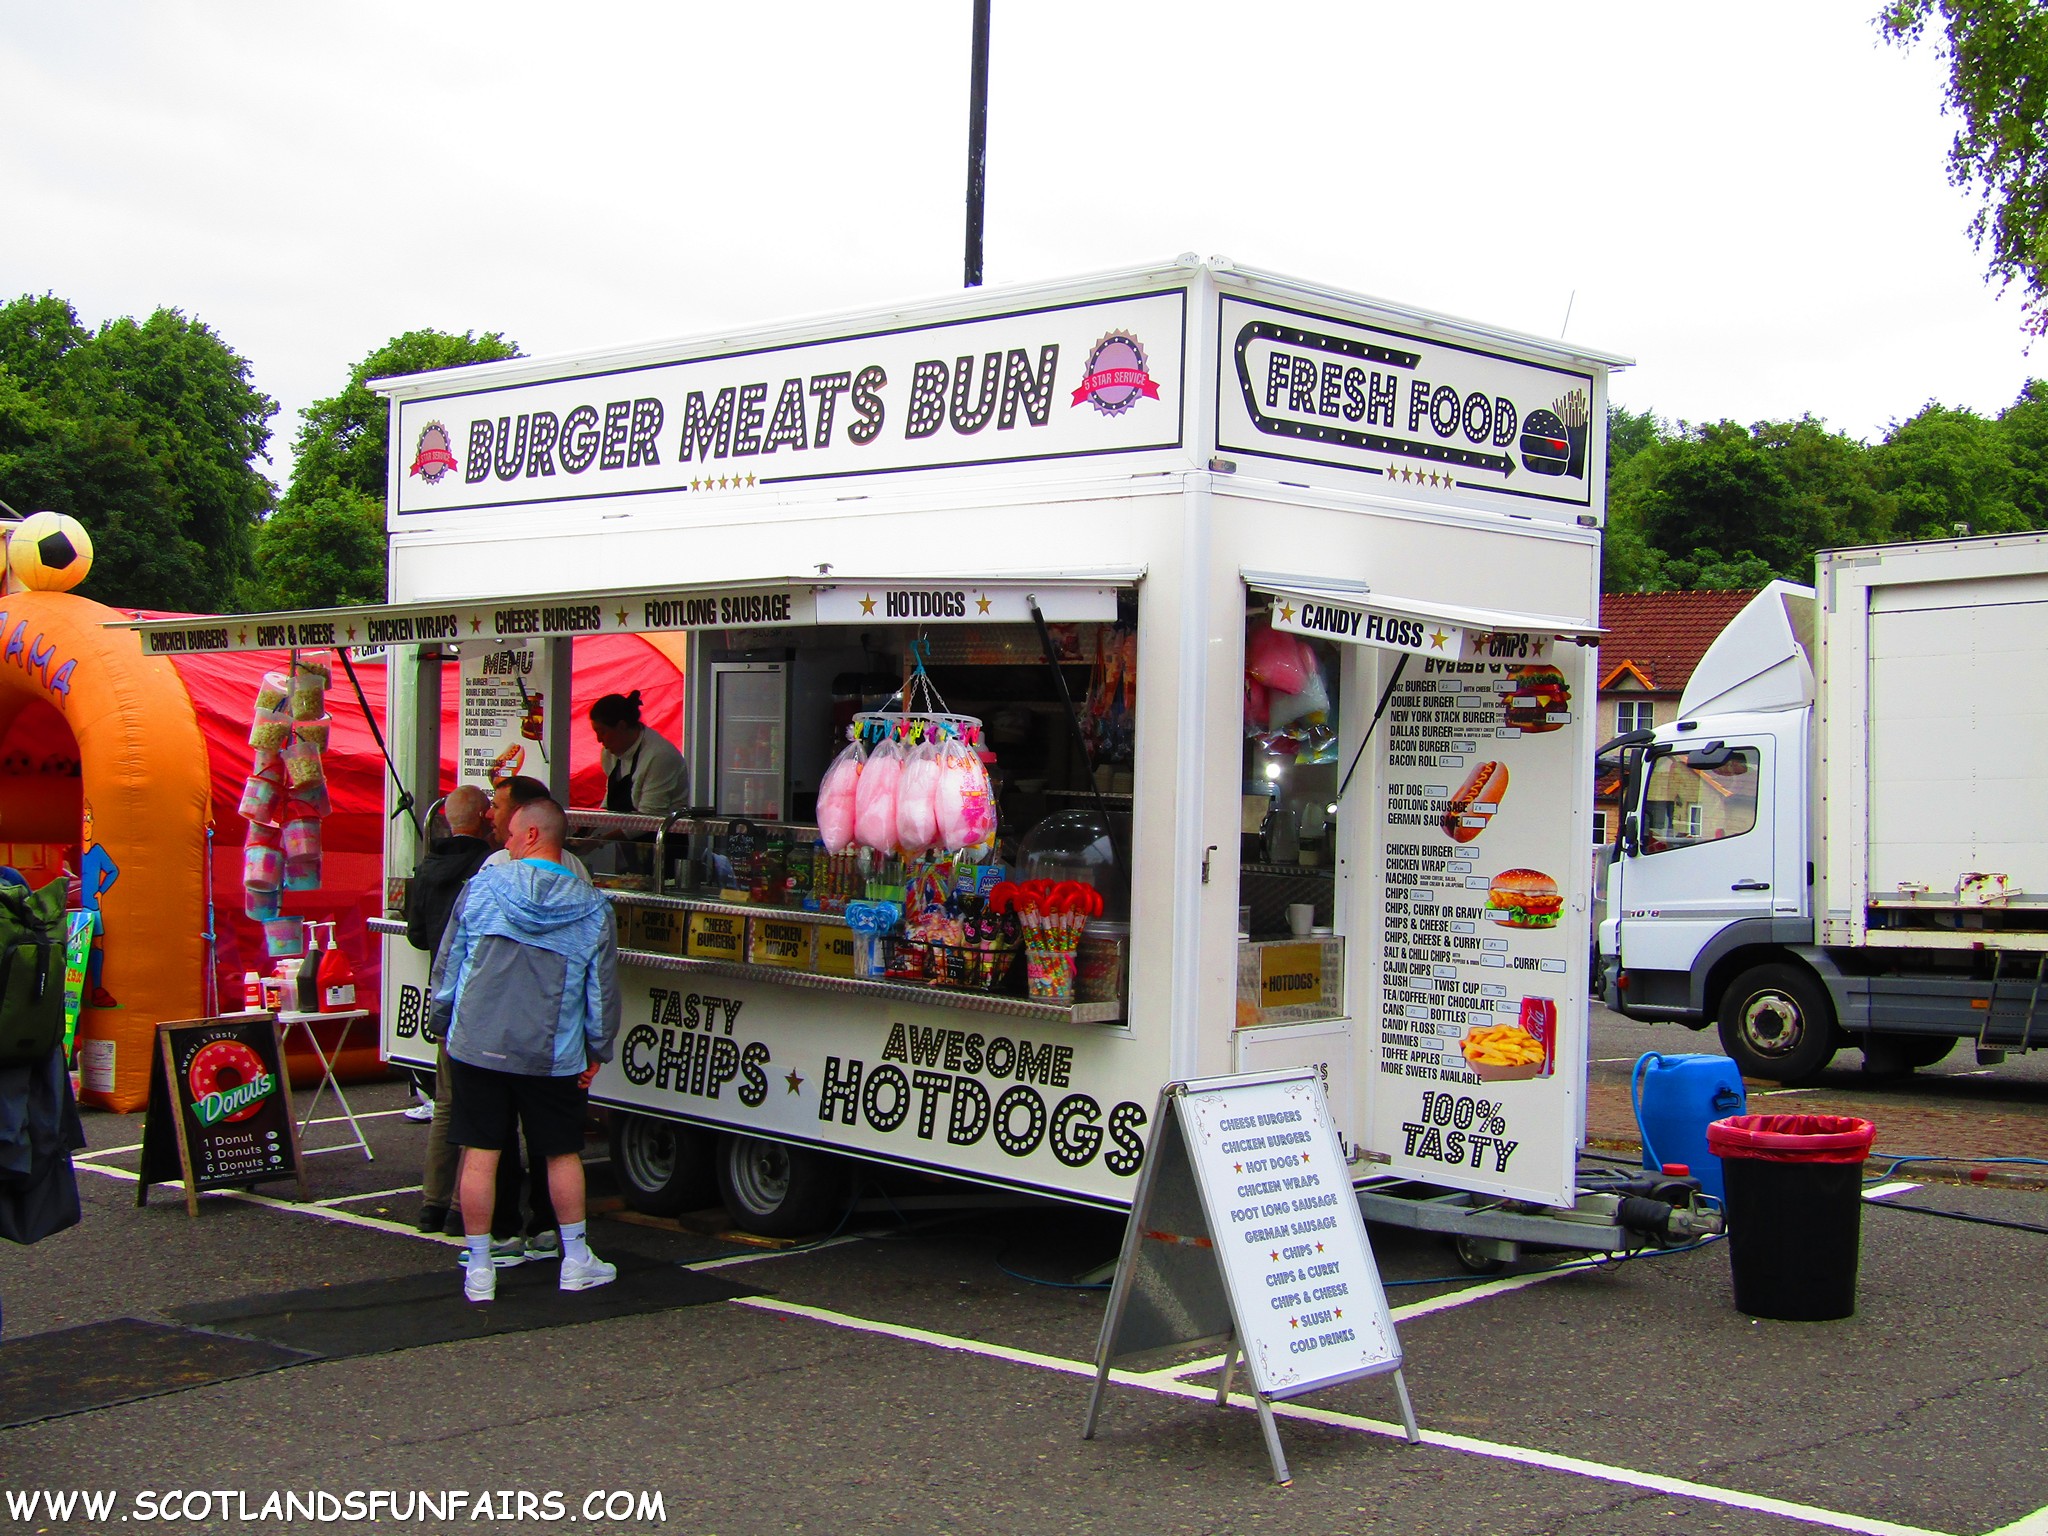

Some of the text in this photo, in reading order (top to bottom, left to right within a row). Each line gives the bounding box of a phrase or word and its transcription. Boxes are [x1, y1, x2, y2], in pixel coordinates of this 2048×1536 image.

[1084, 372, 1146, 390] 5 STAR SERVICE
[1266, 351, 1518, 448] FRESH FOOD
[465, 343, 1060, 484] BURGER MEATS BUN
[150, 591, 966, 651] CHICKEN BURGERS CHIPS & CHEESE CHICKEN WRAPS CHEESE BURGERS FOOTLONG SAUSAGE HOTDOGS
[1301, 603, 1425, 649] CANDY FLOSS
[1489, 633, 1529, 658] CHIPS
[1406, 680, 1437, 693] BURGER
[1391, 696, 1421, 708] DOUBLE
[1423, 696, 1454, 708] BURGER
[1390, 710, 1410, 723] NEW
[1411, 711, 1432, 723] YORK
[1434, 711, 1460, 723] STACK
[1462, 712, 1495, 724] BURGER
[1390, 726, 1453, 738] DALLAS BURGER
[1390, 740, 1417, 752] BACON
[1419, 740, 1450, 753] BURGER
[1389, 754, 1438, 767] BACON ROLL
[1388, 783, 1423, 796] HOT DOG
[1388, 798, 1468, 813] FOOTLONG SAUSAGE
[1387, 813, 1421, 825] GERMAN
[1386, 843, 1453, 858] CHICKEN BURGER
[1386, 858, 1420, 871] CHICKEN
[1421, 860, 1446, 872] WRAP
[1385, 872, 1418, 885] NACHOS
[1385, 887, 1409, 900] CHIPS
[641, 910, 667, 928] CHIPS
[1385, 902, 1483, 920] CHIPS, CURRY OR GRAVY
[702, 917, 734, 934] CHEESE
[764, 924, 802, 941] CHICKEN
[1384, 916, 1449, 932] CHIPS & CHEESE
[645, 926, 672, 943] CURRY
[696, 931, 736, 951] BURGERS
[1384, 931, 1481, 950] CHIPS, CHEESE & CURRY
[765, 940, 799, 958] WRAPS
[1383, 945, 1400, 958] SALT
[1401, 947, 1407, 959] &
[1408, 948, 1429, 961] CHILLI
[1430, 949, 1451, 963] CHIPS
[1513, 956, 1540, 971] CURRY
[1383, 961, 1431, 976] CAJUN CHIPS
[1269, 972, 1314, 993] HOTDOGS
[1383, 974, 1408, 988] SLUSH
[1434, 979, 1460, 992] TWIST
[1462, 981, 1480, 995] CUP
[649, 987, 743, 1036] TASTY
[1383, 1003, 1466, 1023] CANS BOTTLES
[1447, 996, 1495, 1012] CHOCOLATE
[1382, 1018, 1409, 1032] CANDY
[1410, 1021, 1436, 1035] FLOSS
[210, 1031, 239, 1041] tasty
[1382, 1032, 1419, 1048] DUMMIES
[882, 1022, 1074, 1089] AWESOME
[1382, 1046, 1440, 1065] TOFFEE APPLES
[622, 1024, 772, 1109] CHIPS
[1380, 1061, 1482, 1086] MORE SWEETS AVAILABLE
[200, 1071, 272, 1123] Donuts
[818, 1056, 1149, 1178] HOTDOGS
[1219, 1109, 1303, 1132] CHEESE BURGERS
[1421, 1090, 1506, 1136] 100%
[203, 1138, 209, 1148] 1
[215, 1133, 254, 1146] Donut
[1221, 1130, 1312, 1154] CHICKEN BURGERS
[1402, 1122, 1519, 1173] TASTY
[204, 1151, 213, 1161] 3
[217, 1145, 262, 1159] Donuts
[207, 1163, 215, 1173] 6
[219, 1158, 264, 1171] Donuts
[1245, 1154, 1300, 1174] HOT DOGS
[1237, 1173, 1320, 1198] CHICKEN WRAPS
[1230, 1193, 1339, 1223] FOOT LONG SAUSAGE
[1244, 1216, 1338, 1244] GERMAN SAUSAGE
[1282, 1243, 1313, 1260] CHIPS
[1265, 1261, 1340, 1288] CHIPS & CURRY
[1270, 1282, 1349, 1310] CHIPS & CHEESE
[1300, 1310, 1333, 1327] SLUSH
[1289, 1328, 1356, 1354] COLD DRINKS
